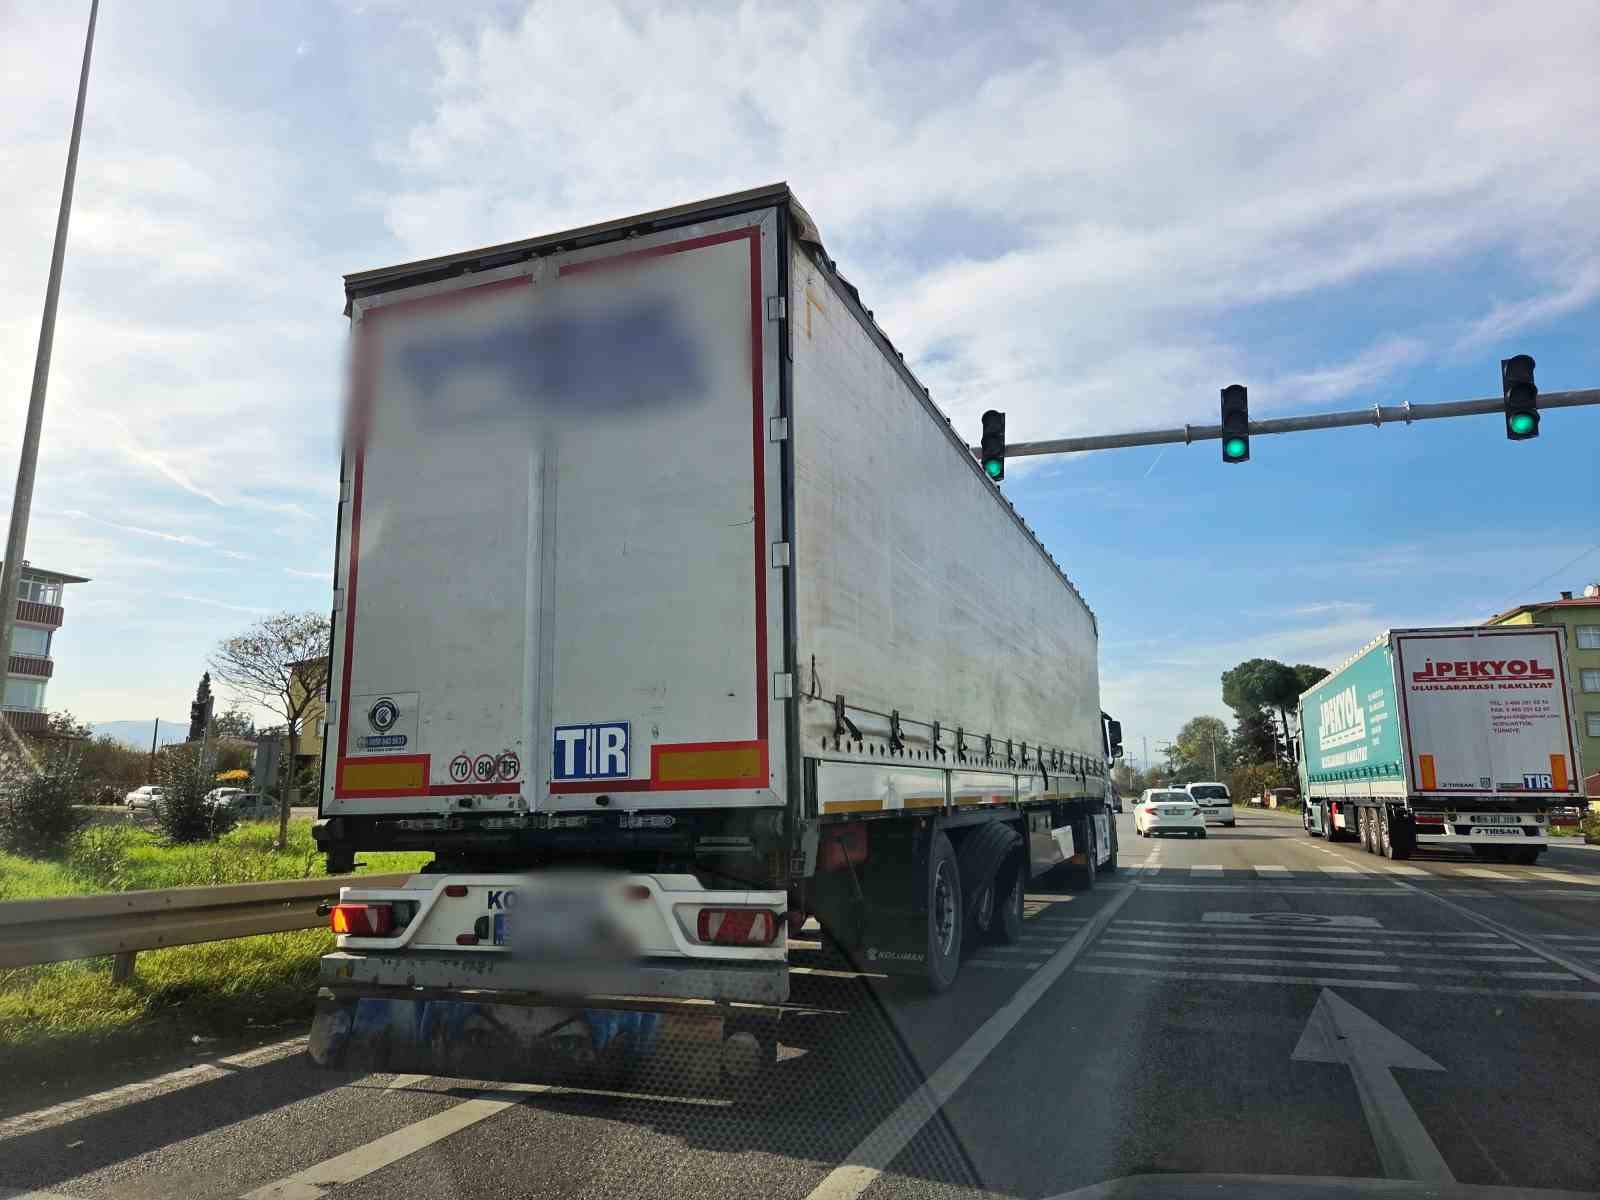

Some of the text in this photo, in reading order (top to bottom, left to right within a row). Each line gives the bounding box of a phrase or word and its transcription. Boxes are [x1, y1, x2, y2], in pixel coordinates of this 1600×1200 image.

[556, 727, 626, 776] TIR
[455, 760, 517, 777] 70 80 TR
[1524, 774, 1552, 789] TIR
